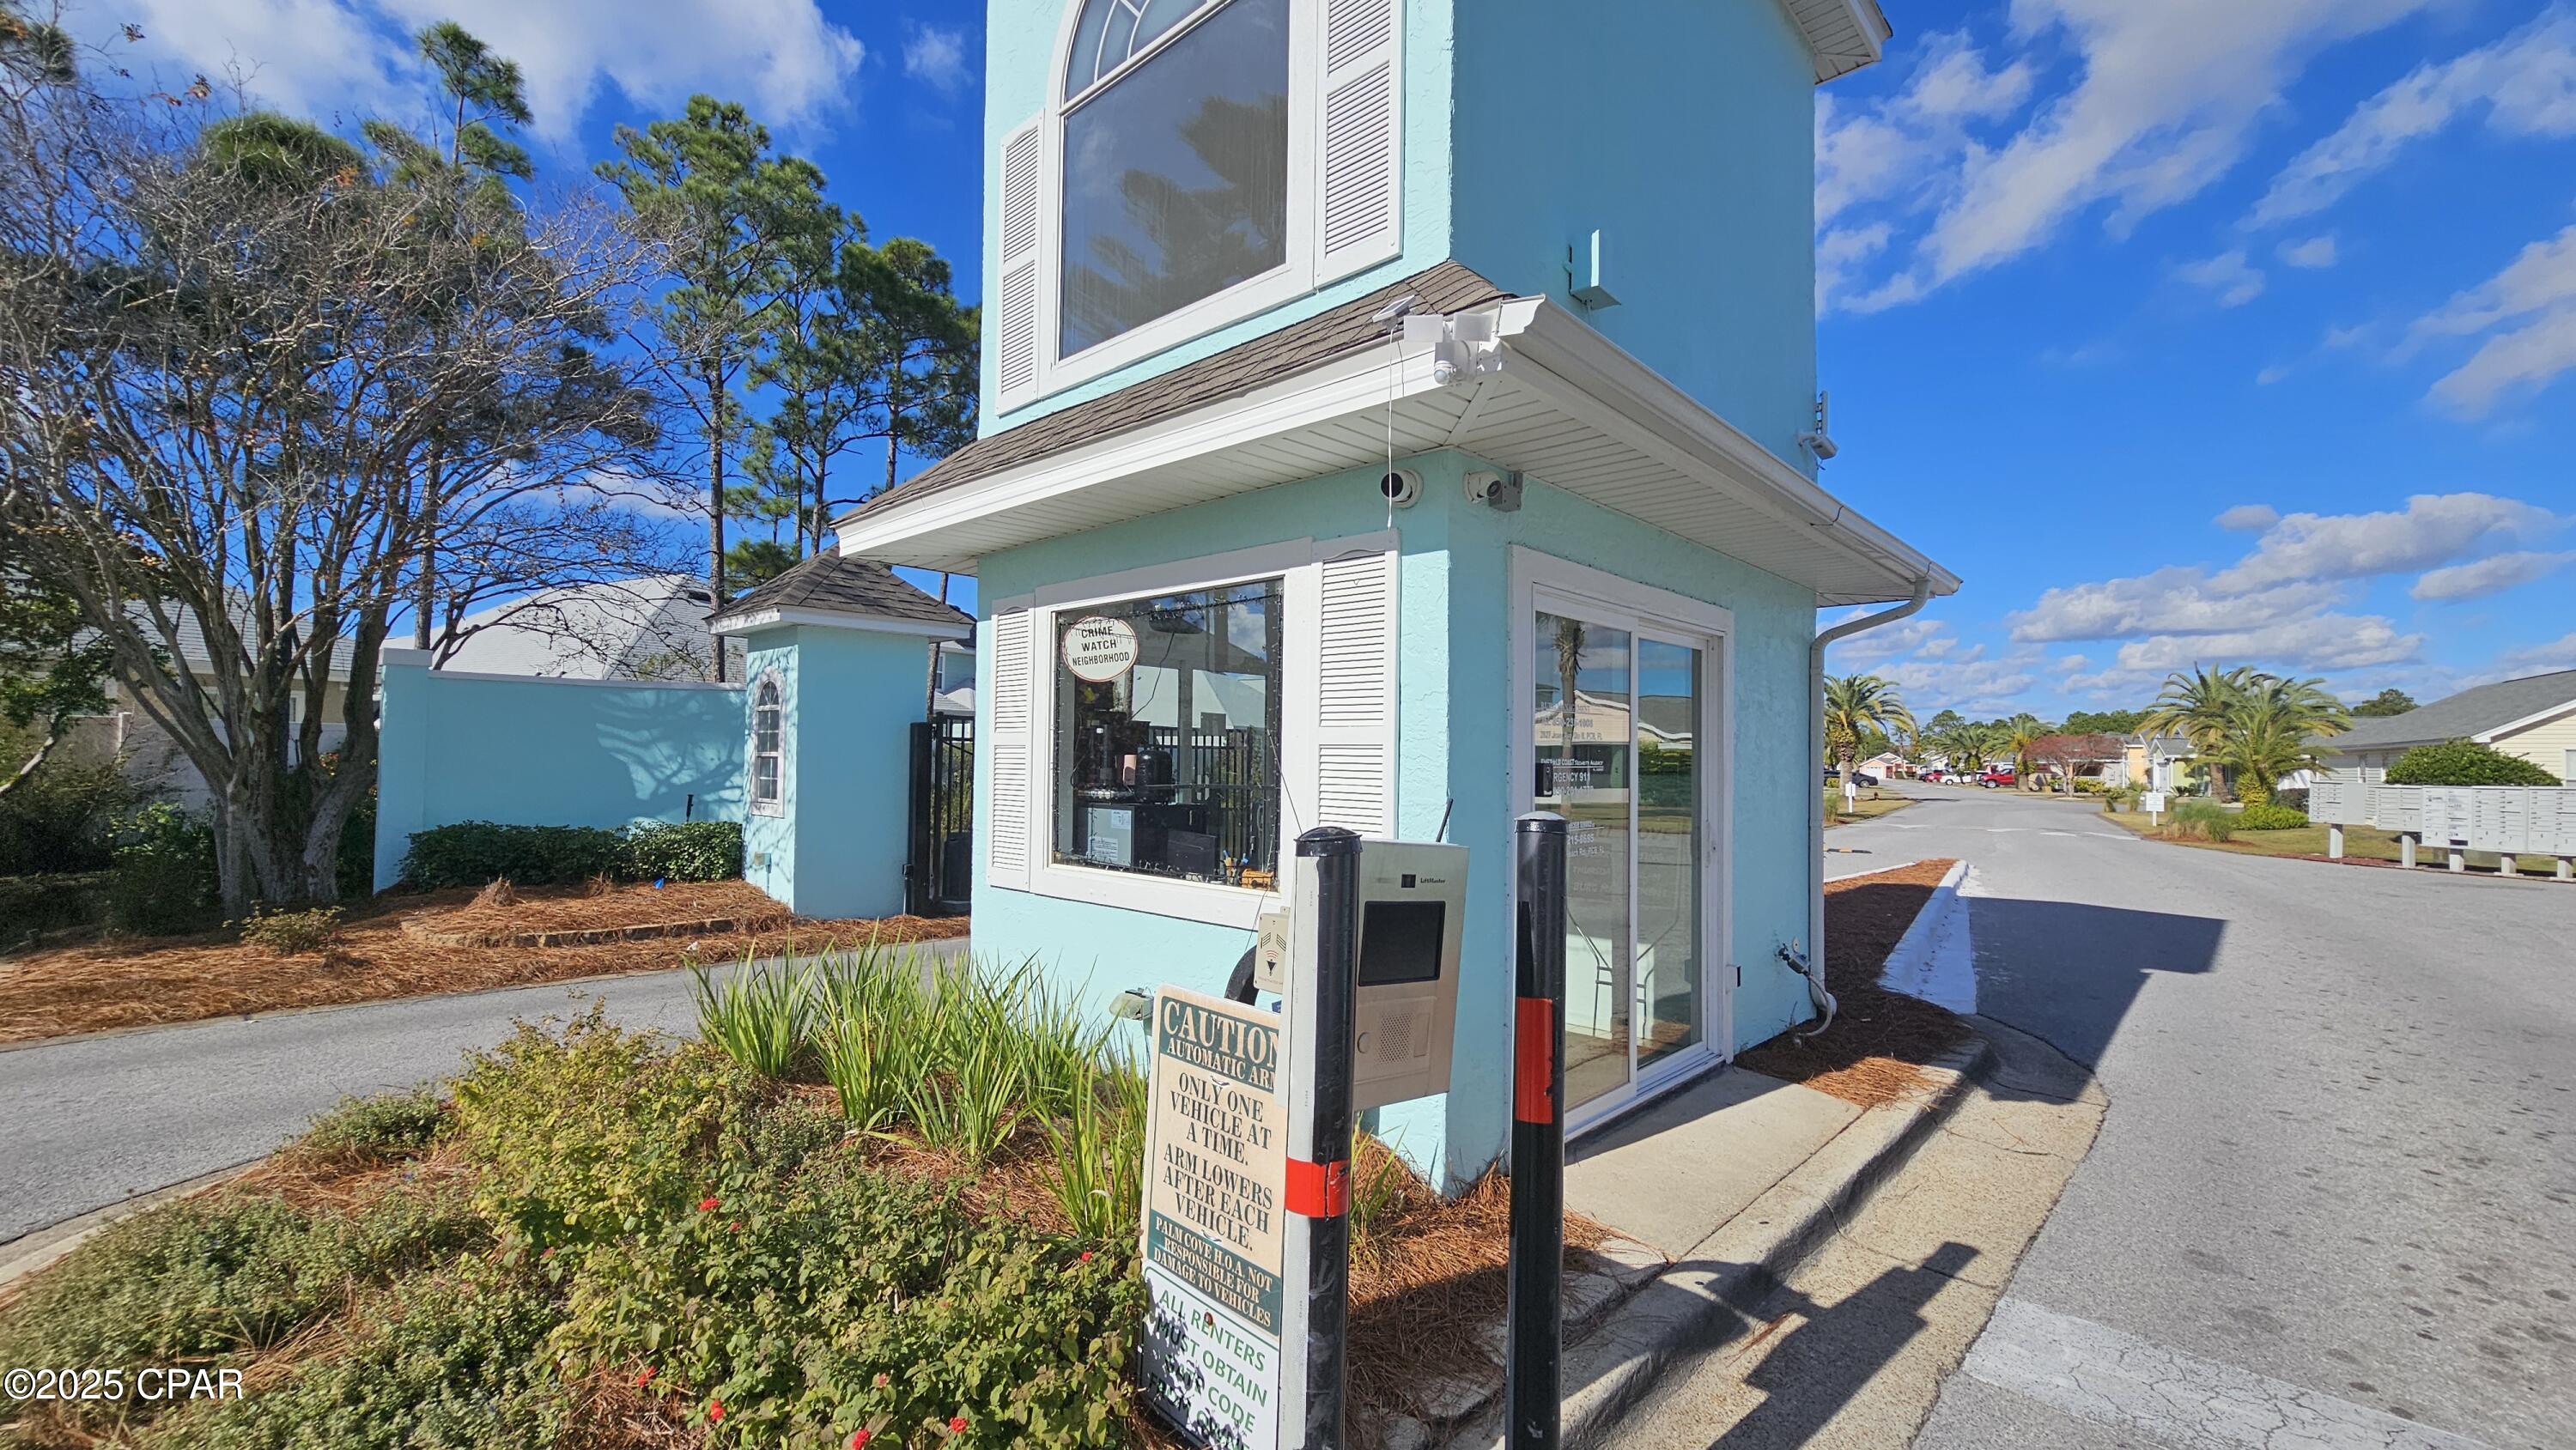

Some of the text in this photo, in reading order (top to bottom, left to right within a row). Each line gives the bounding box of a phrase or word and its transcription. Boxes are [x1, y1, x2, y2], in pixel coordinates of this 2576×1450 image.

[1072, 652, 1130, 666] NEIGHBORHOOD
[1081, 625, 1114, 639] CRIME
[1081, 639, 1117, 652] WATCH
[1579, 772, 1590, 782] 911
[1164, 1001, 1279, 1068] CAUTION
[1168, 1037, 1246, 1079] AUTOMATIC
[1170, 1090, 1271, 1150] VEHICLE AT
[1179, 1072, 1263, 1122] ONLY ONE
[1186, 1121, 1248, 1166] A TIME.
[1163, 1143, 1273, 1210] ARM LOWERS
[1163, 1165, 1269, 1235] AFTER EACH
[1176, 1192, 1253, 1252] VEHICLE.
[1155, 1216, 1182, 1244] PALM
[1184, 1233, 1212, 1259] COVE
[1249, 1265, 1273, 1292] NOT
[1164, 1236, 1260, 1303] RESPONSIBLE FOR
[1154, 1247, 1196, 1283] DAMAGE
[1196, 1273, 1212, 1292] TO
[1213, 1281, 1271, 1327] VEHICLES
[1159, 1289, 1266, 1372] ALL RENTERS
[1156, 1317, 1267, 1408] MUST OBTAIN
[1208, 1386, 1255, 1434] CODE
